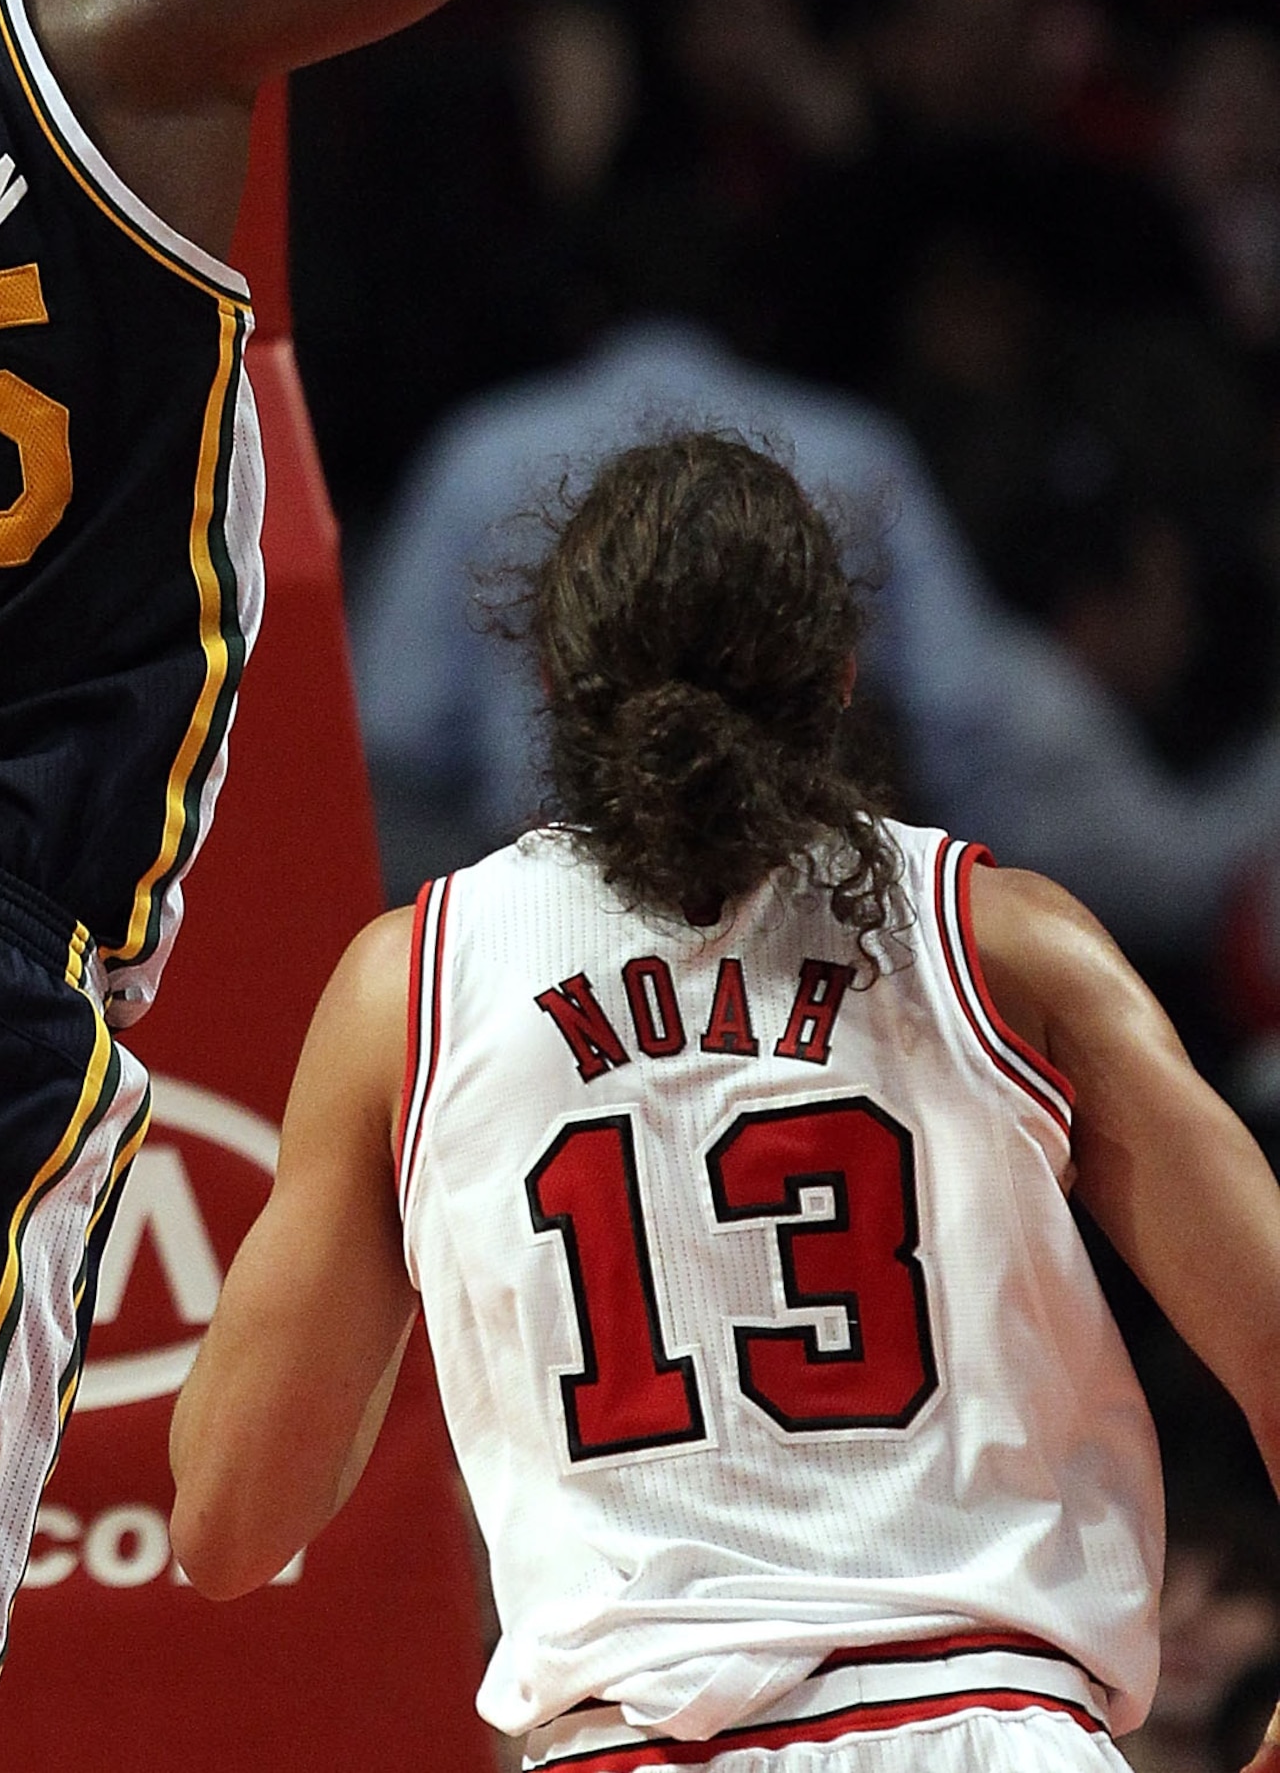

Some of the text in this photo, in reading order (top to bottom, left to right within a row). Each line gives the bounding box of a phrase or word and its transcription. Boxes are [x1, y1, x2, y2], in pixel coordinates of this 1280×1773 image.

[534, 955, 857, 1083] NOAH
[523, 1094, 940, 1464] 13
[20, 1502, 307, 1589] co
